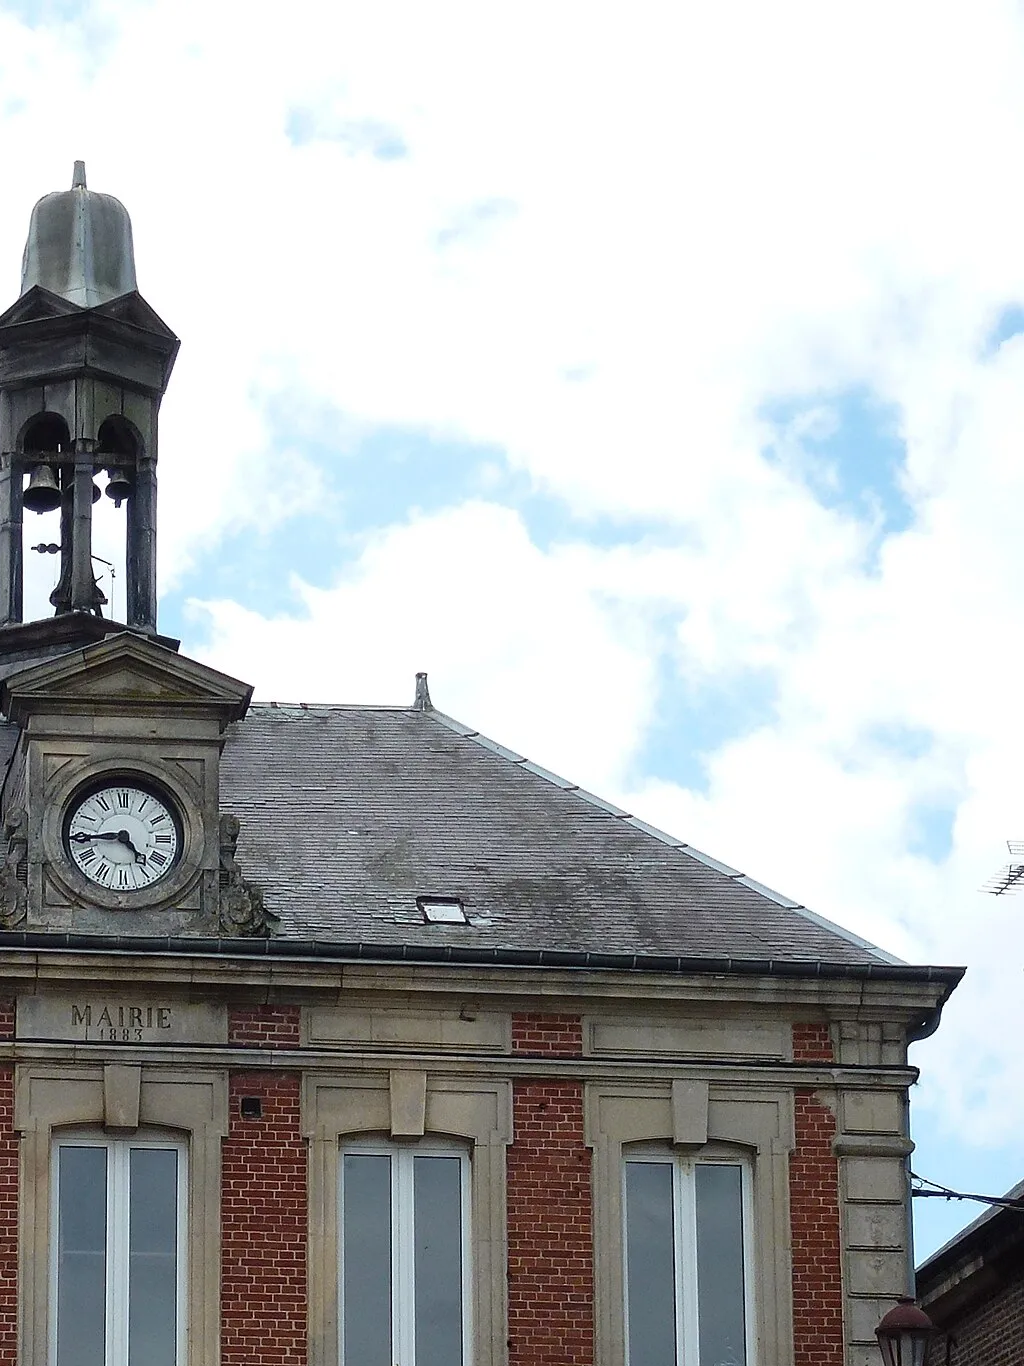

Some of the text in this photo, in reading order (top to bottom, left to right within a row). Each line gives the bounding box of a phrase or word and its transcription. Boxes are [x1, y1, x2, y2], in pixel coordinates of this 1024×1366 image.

[149, 813, 166, 826] II
[155, 834, 172, 844] III
[71, 1005, 172, 1029] MAIRIE
[100, 1028, 143, 1041] 1883
